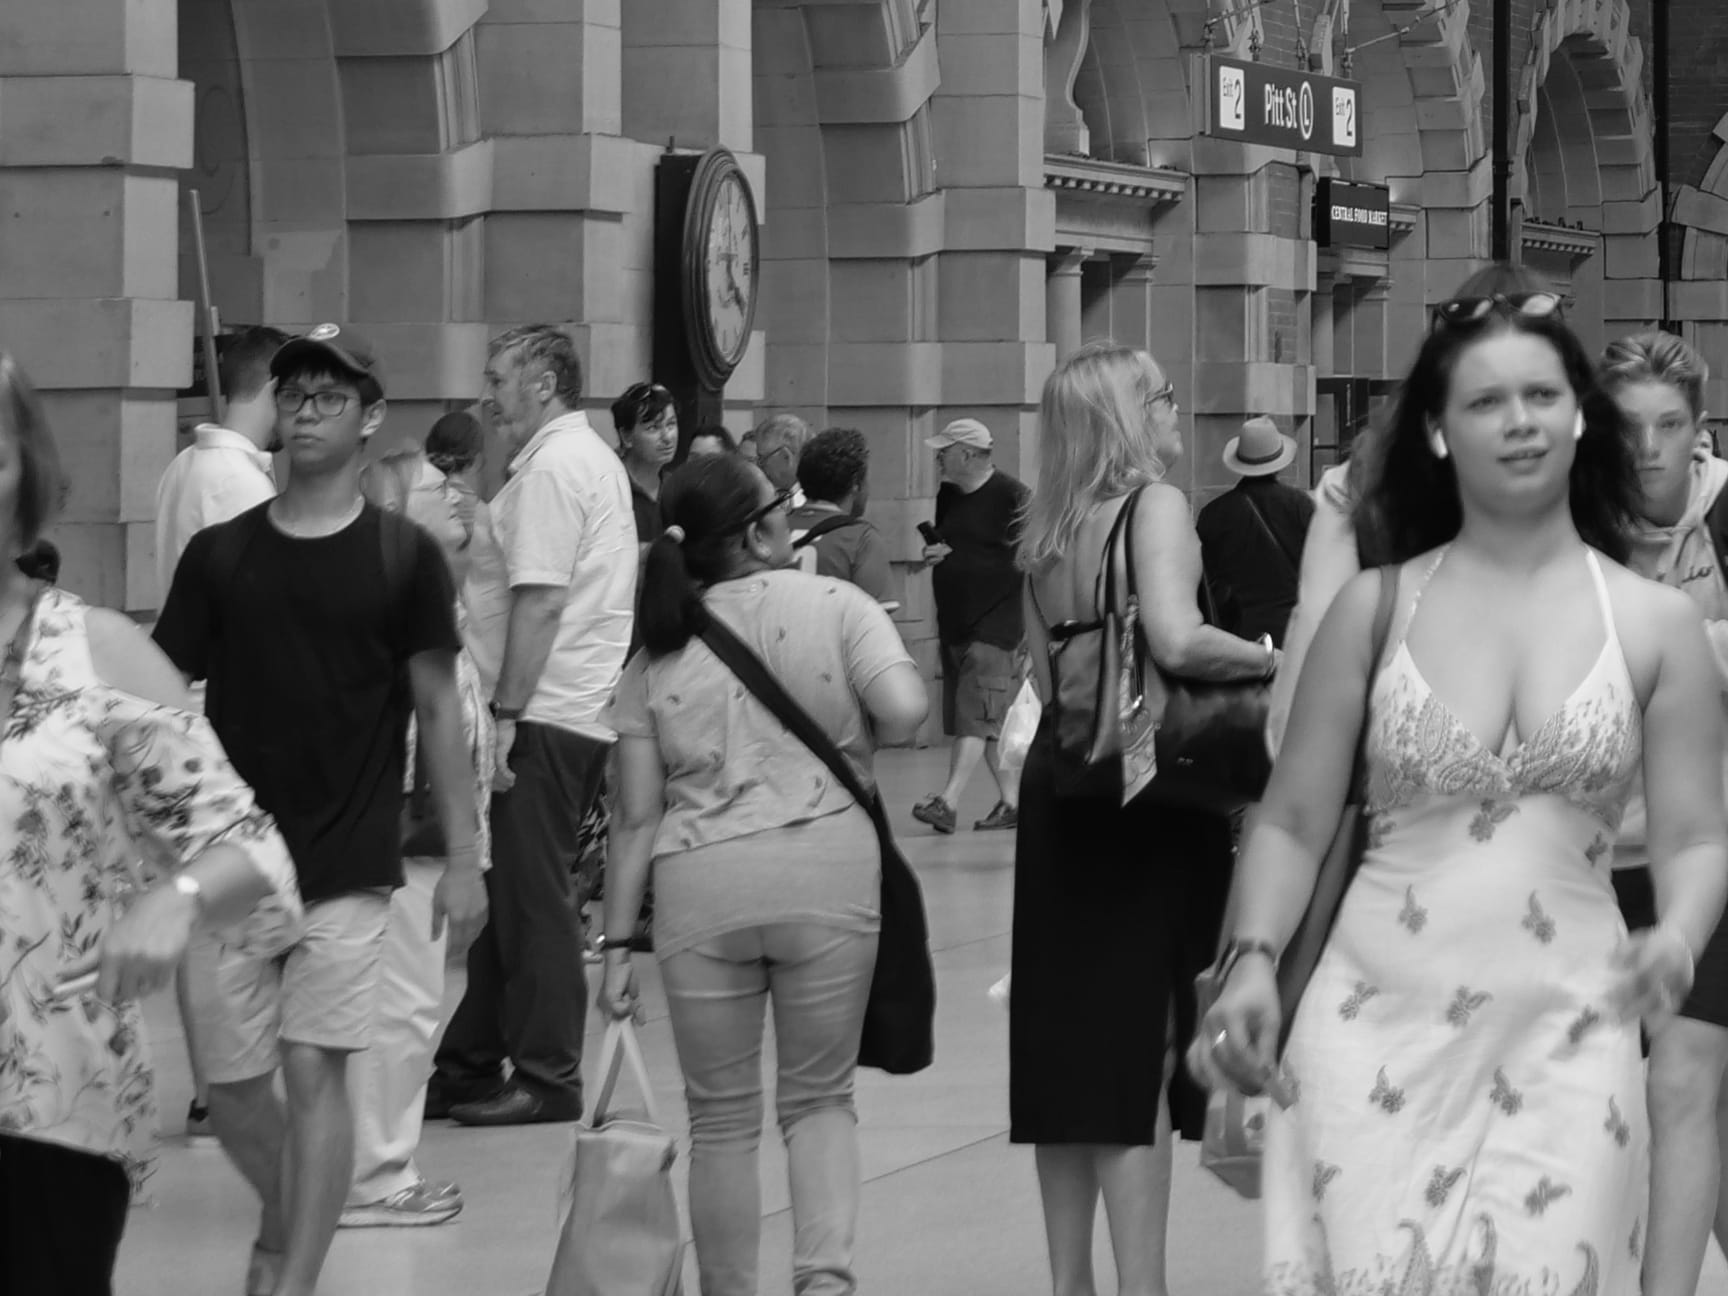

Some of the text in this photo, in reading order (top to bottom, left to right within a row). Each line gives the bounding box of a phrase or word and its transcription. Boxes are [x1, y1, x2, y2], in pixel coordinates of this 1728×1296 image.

[1235, 78, 1243, 120] 2
[1264, 83, 1284, 126] Pitt
[1285, 87, 1298, 128] St
[1346, 98, 1354, 137] 2
